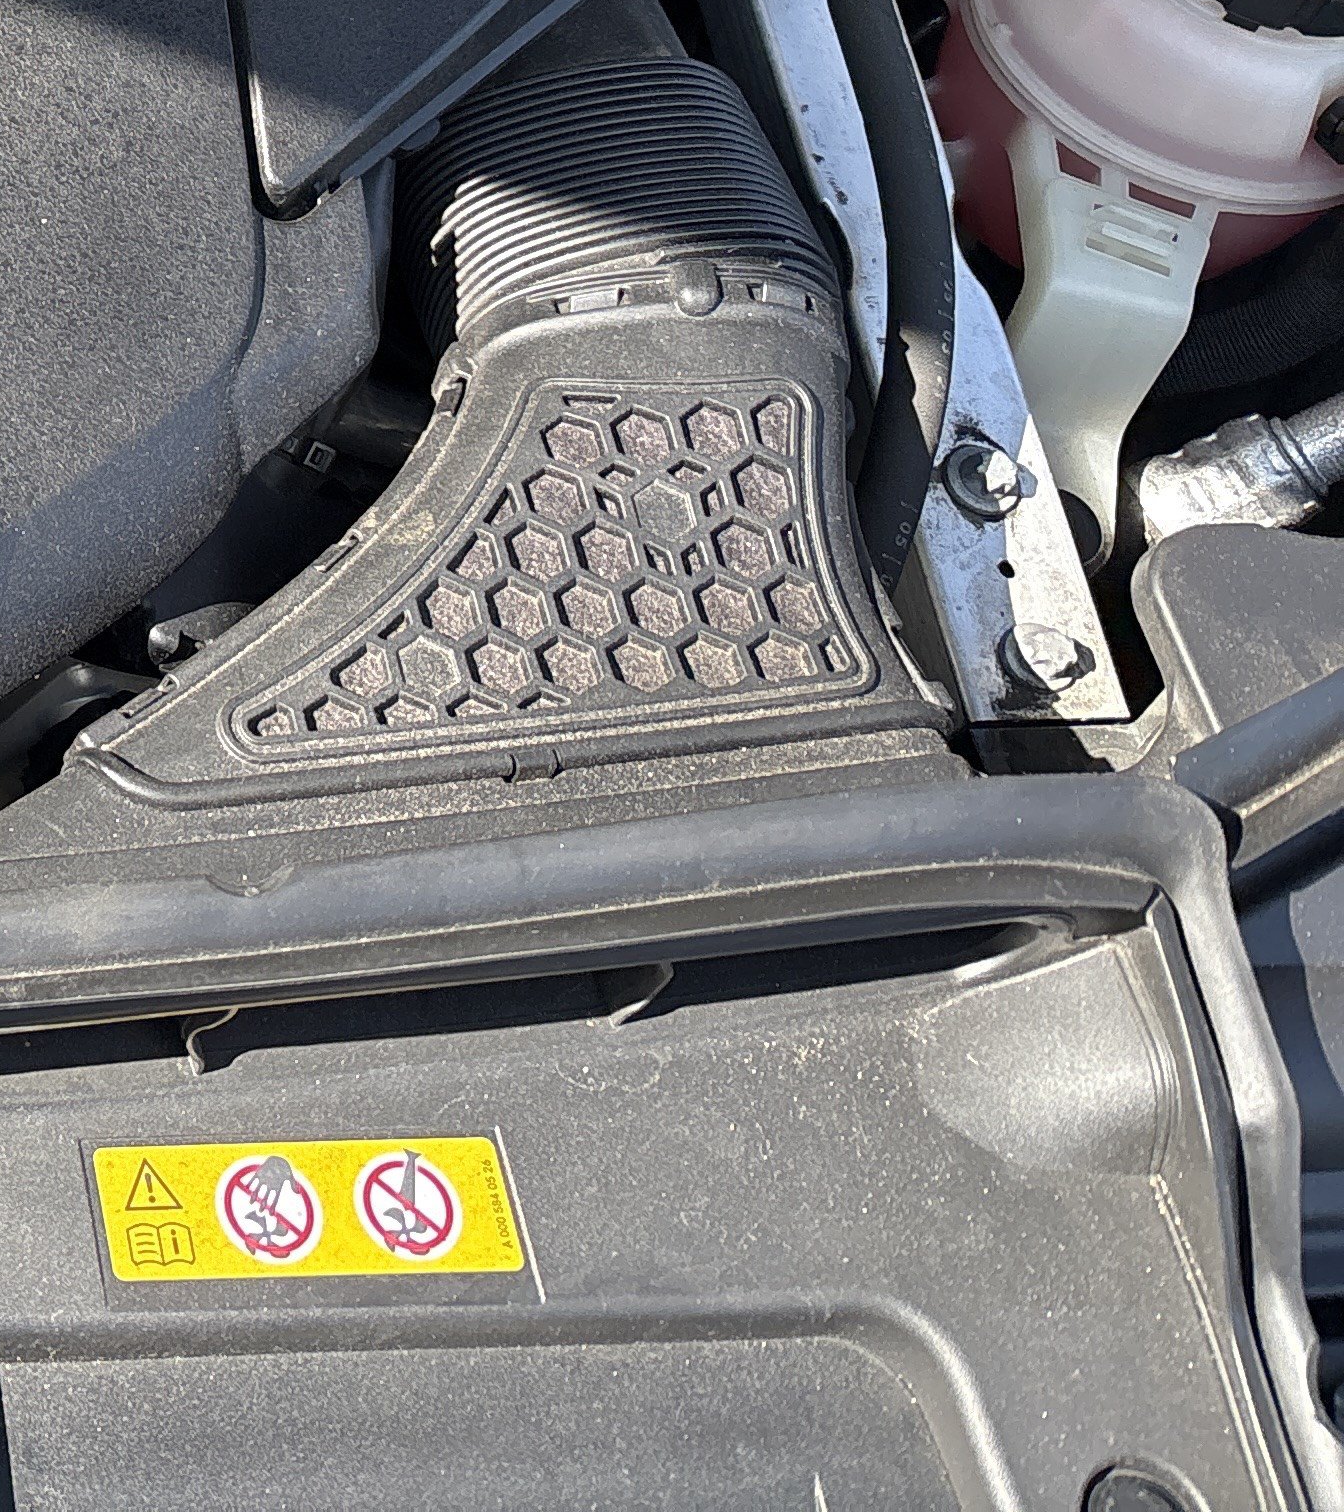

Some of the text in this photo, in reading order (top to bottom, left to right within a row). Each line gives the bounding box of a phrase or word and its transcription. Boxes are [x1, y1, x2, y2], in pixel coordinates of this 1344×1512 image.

[485, 1176, 497, 1190] 05
[496, 1217, 509, 1237] 000
[502, 1240, 513, 1249] A
